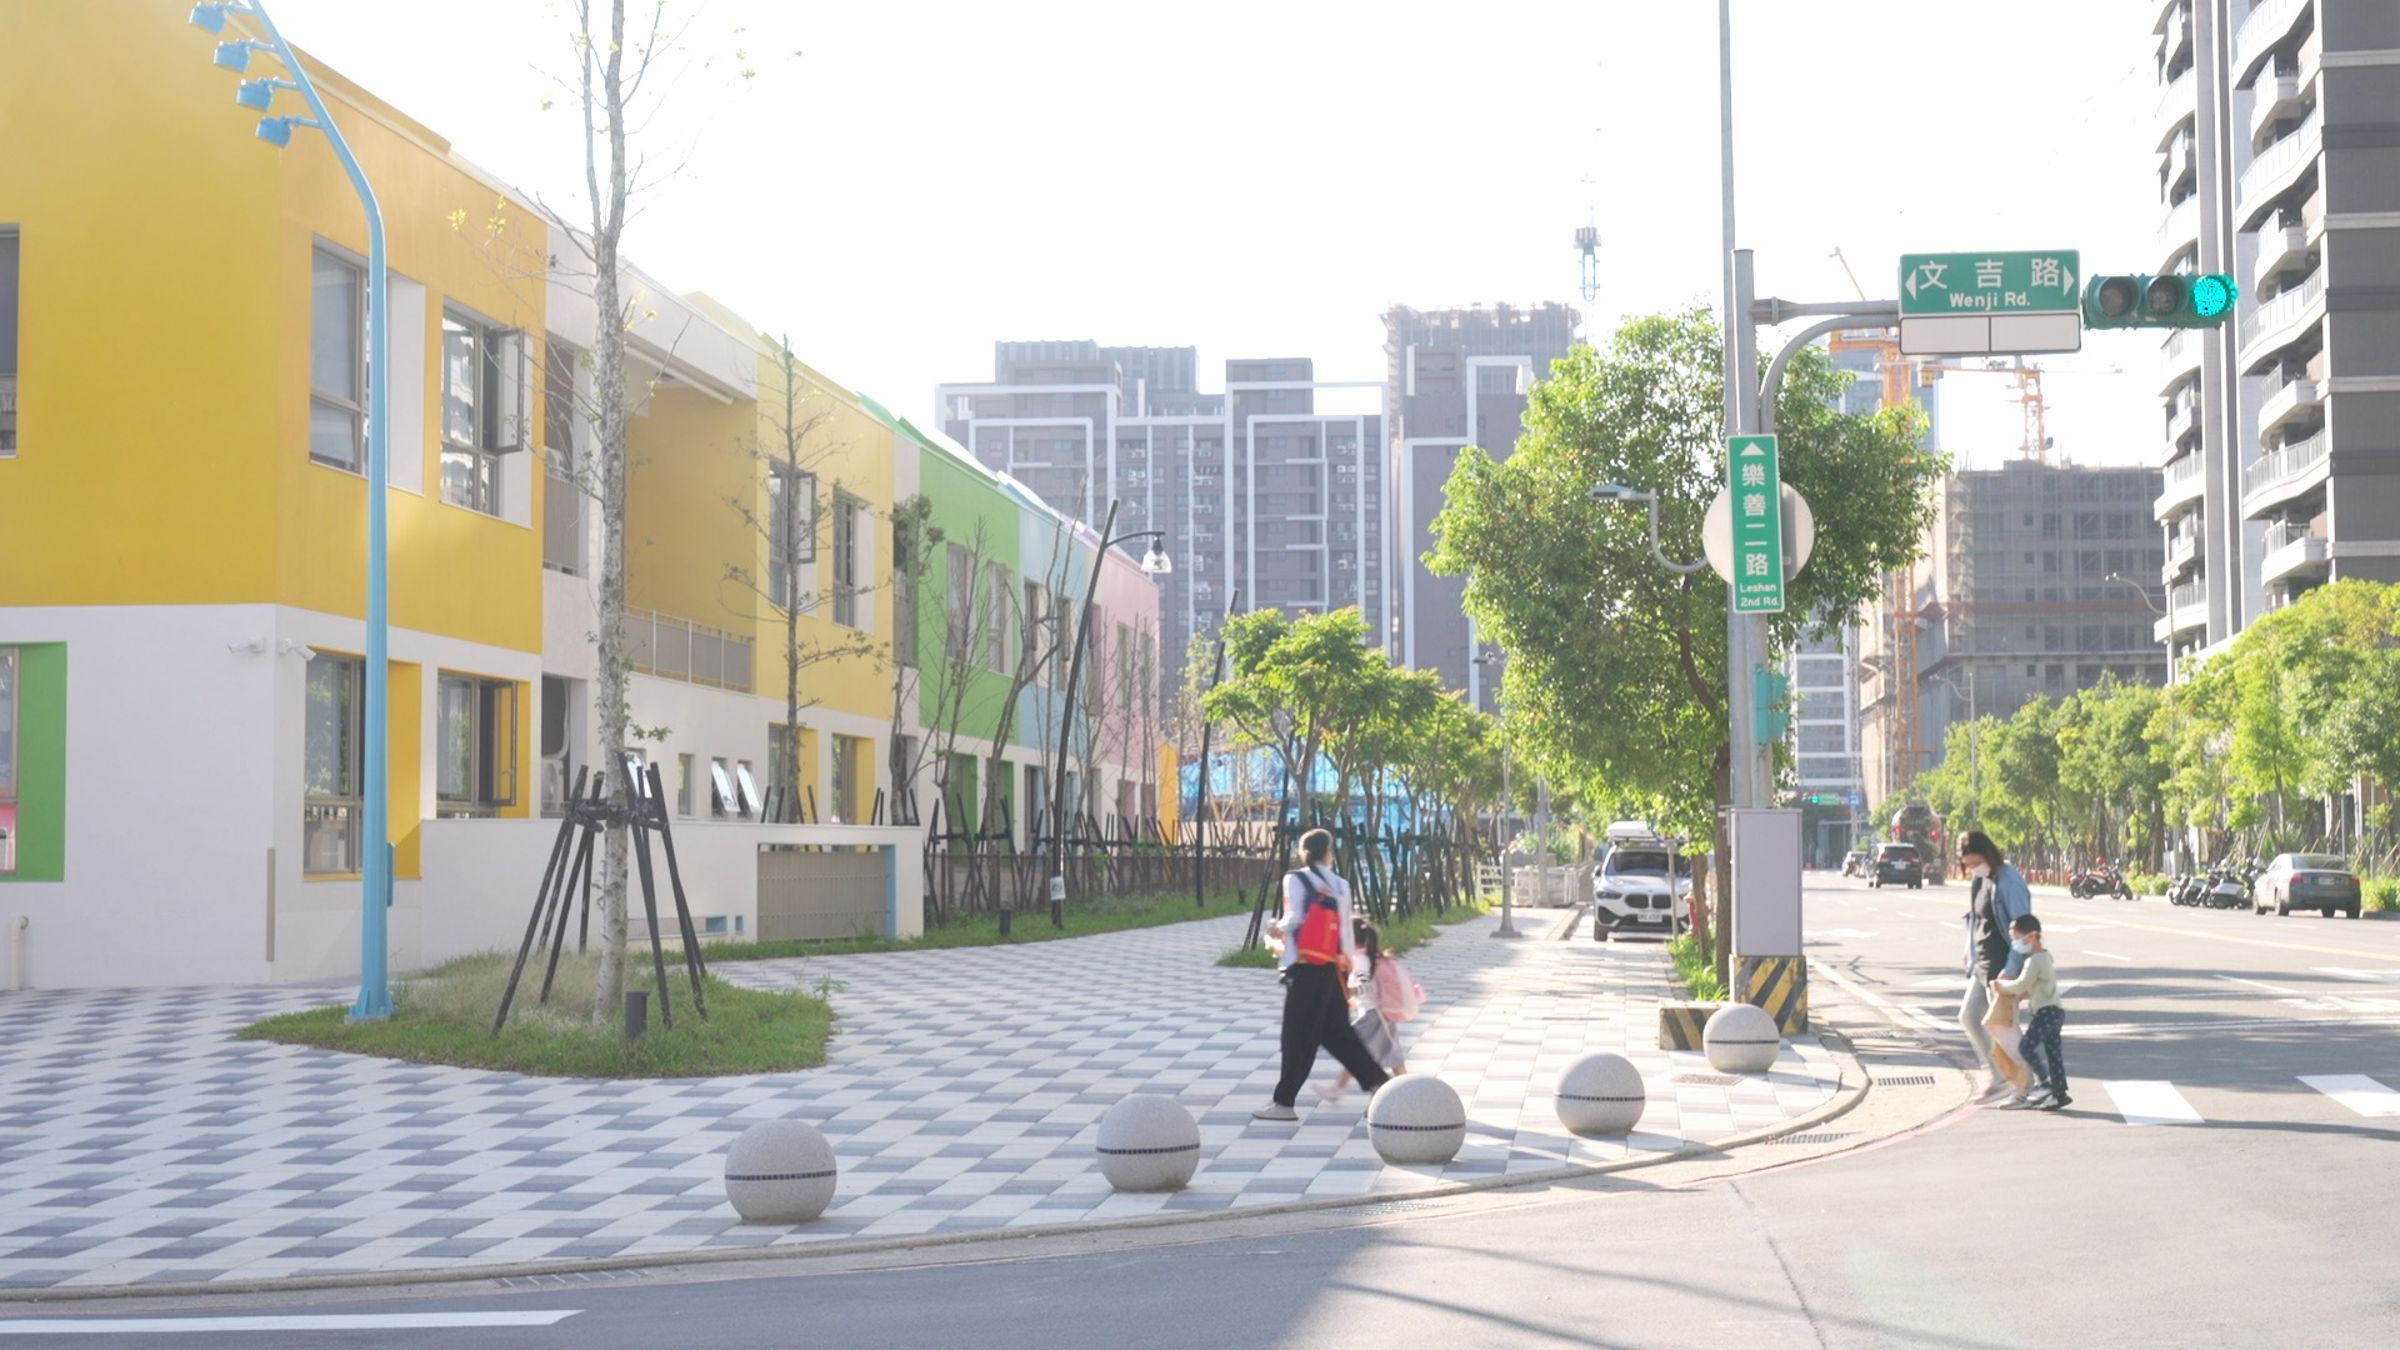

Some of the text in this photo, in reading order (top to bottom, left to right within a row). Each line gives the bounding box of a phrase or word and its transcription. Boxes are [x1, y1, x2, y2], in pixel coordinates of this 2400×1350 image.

[1919, 257, 2060, 290] 文吉路
[1950, 291, 2031, 311] Wenji Rd.
[1742, 463, 1768, 576] 樂善二路
[1739, 583, 1777, 593] Leshan
[1740, 596, 1780, 607] 2nd Rd.
